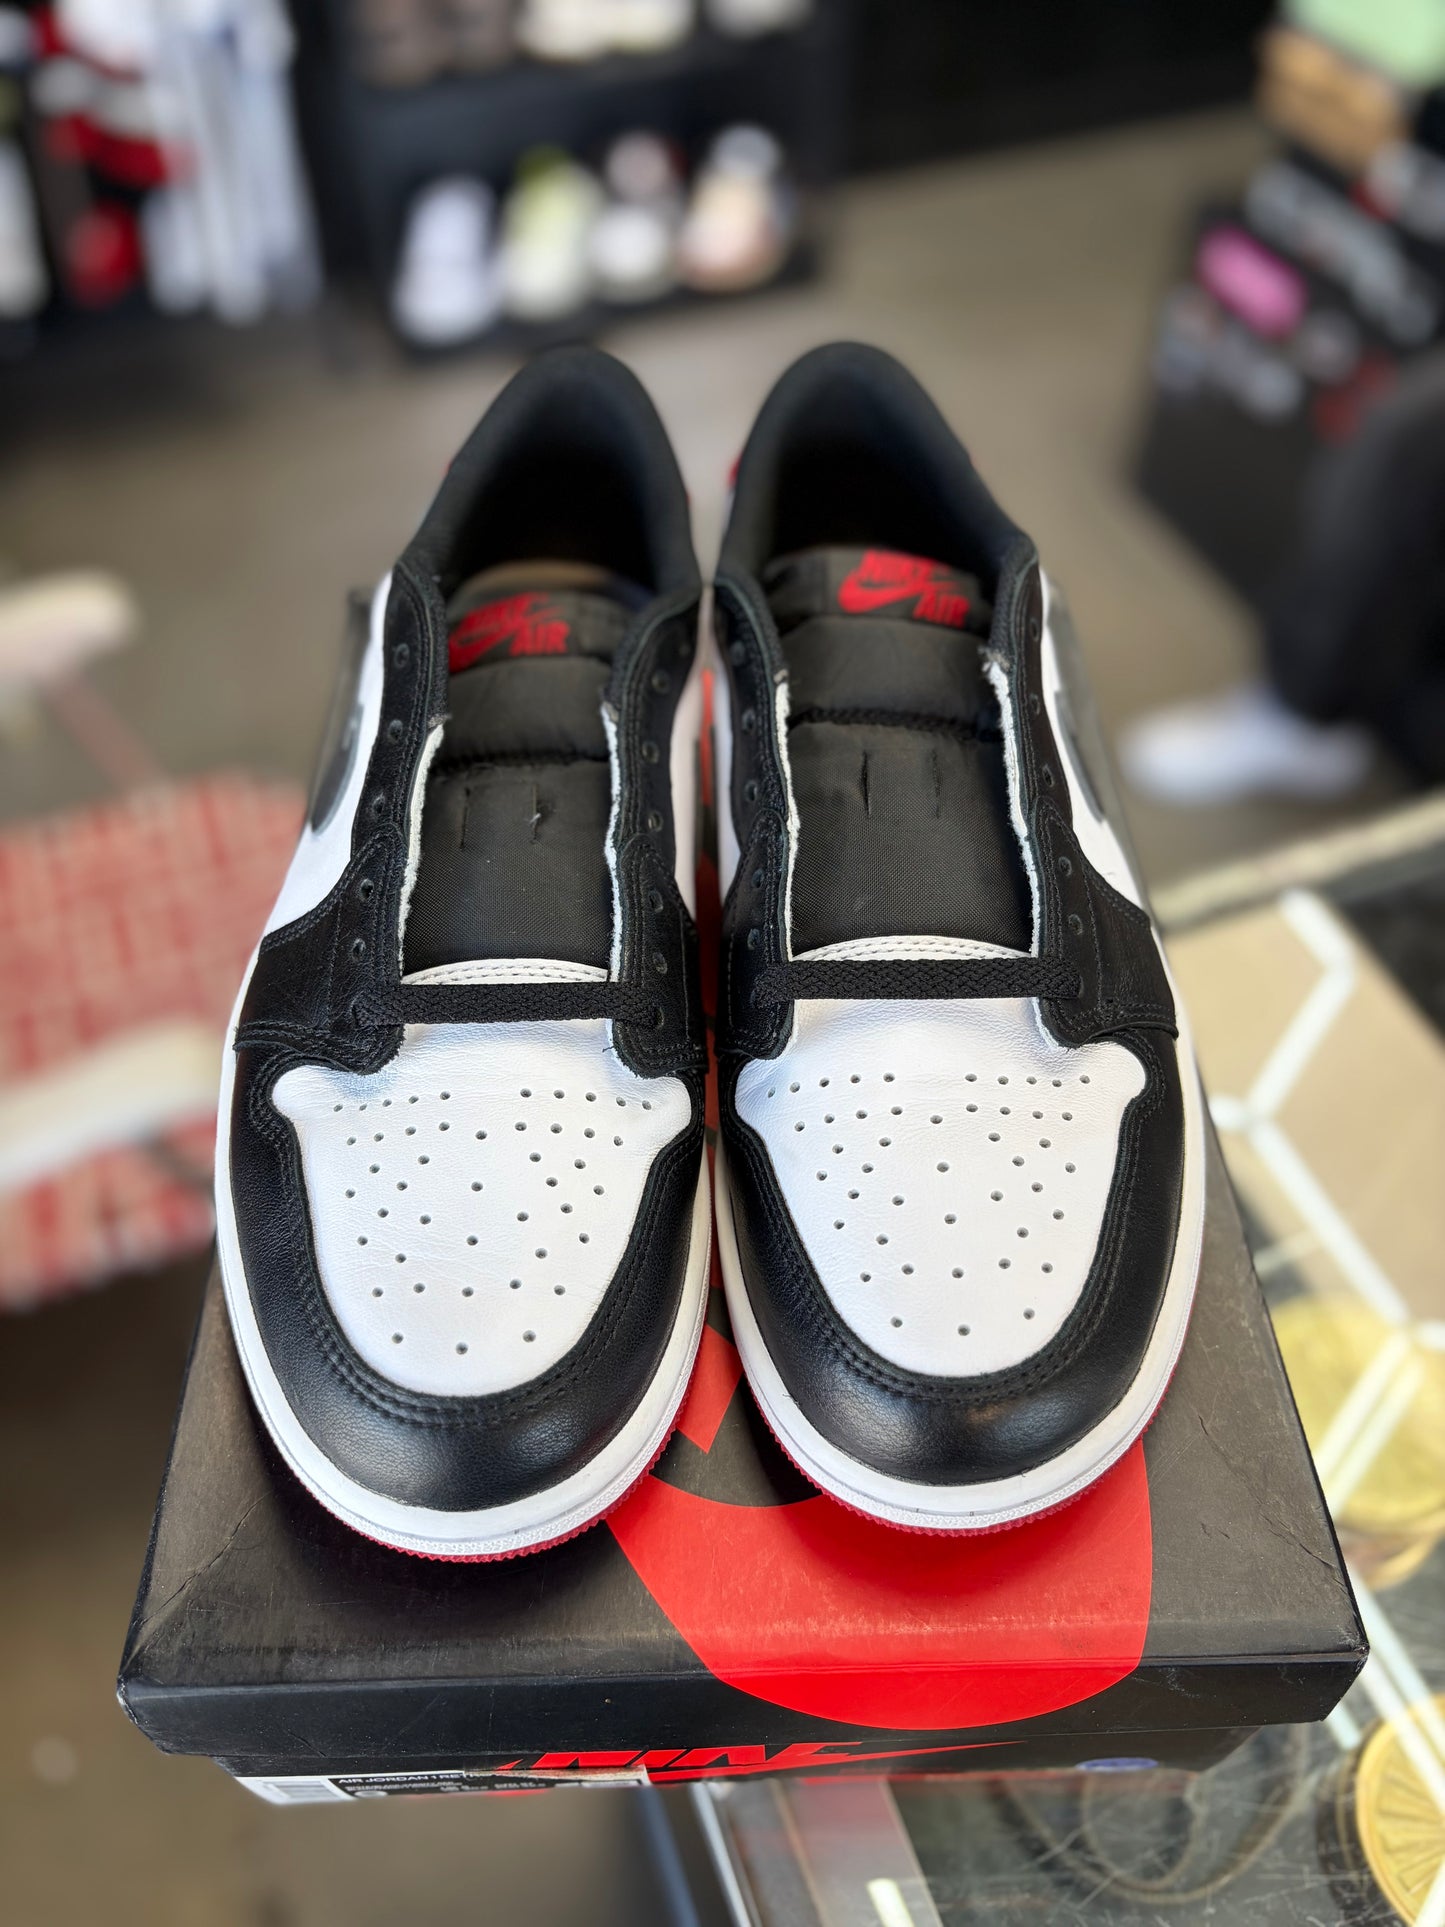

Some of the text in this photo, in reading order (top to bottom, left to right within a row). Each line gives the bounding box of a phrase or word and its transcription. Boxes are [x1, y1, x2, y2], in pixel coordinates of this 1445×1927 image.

[911, 588, 970, 629] AIR
[509, 620, 570, 656] AIR
[366, 1773, 429, 1784] JORDAN
